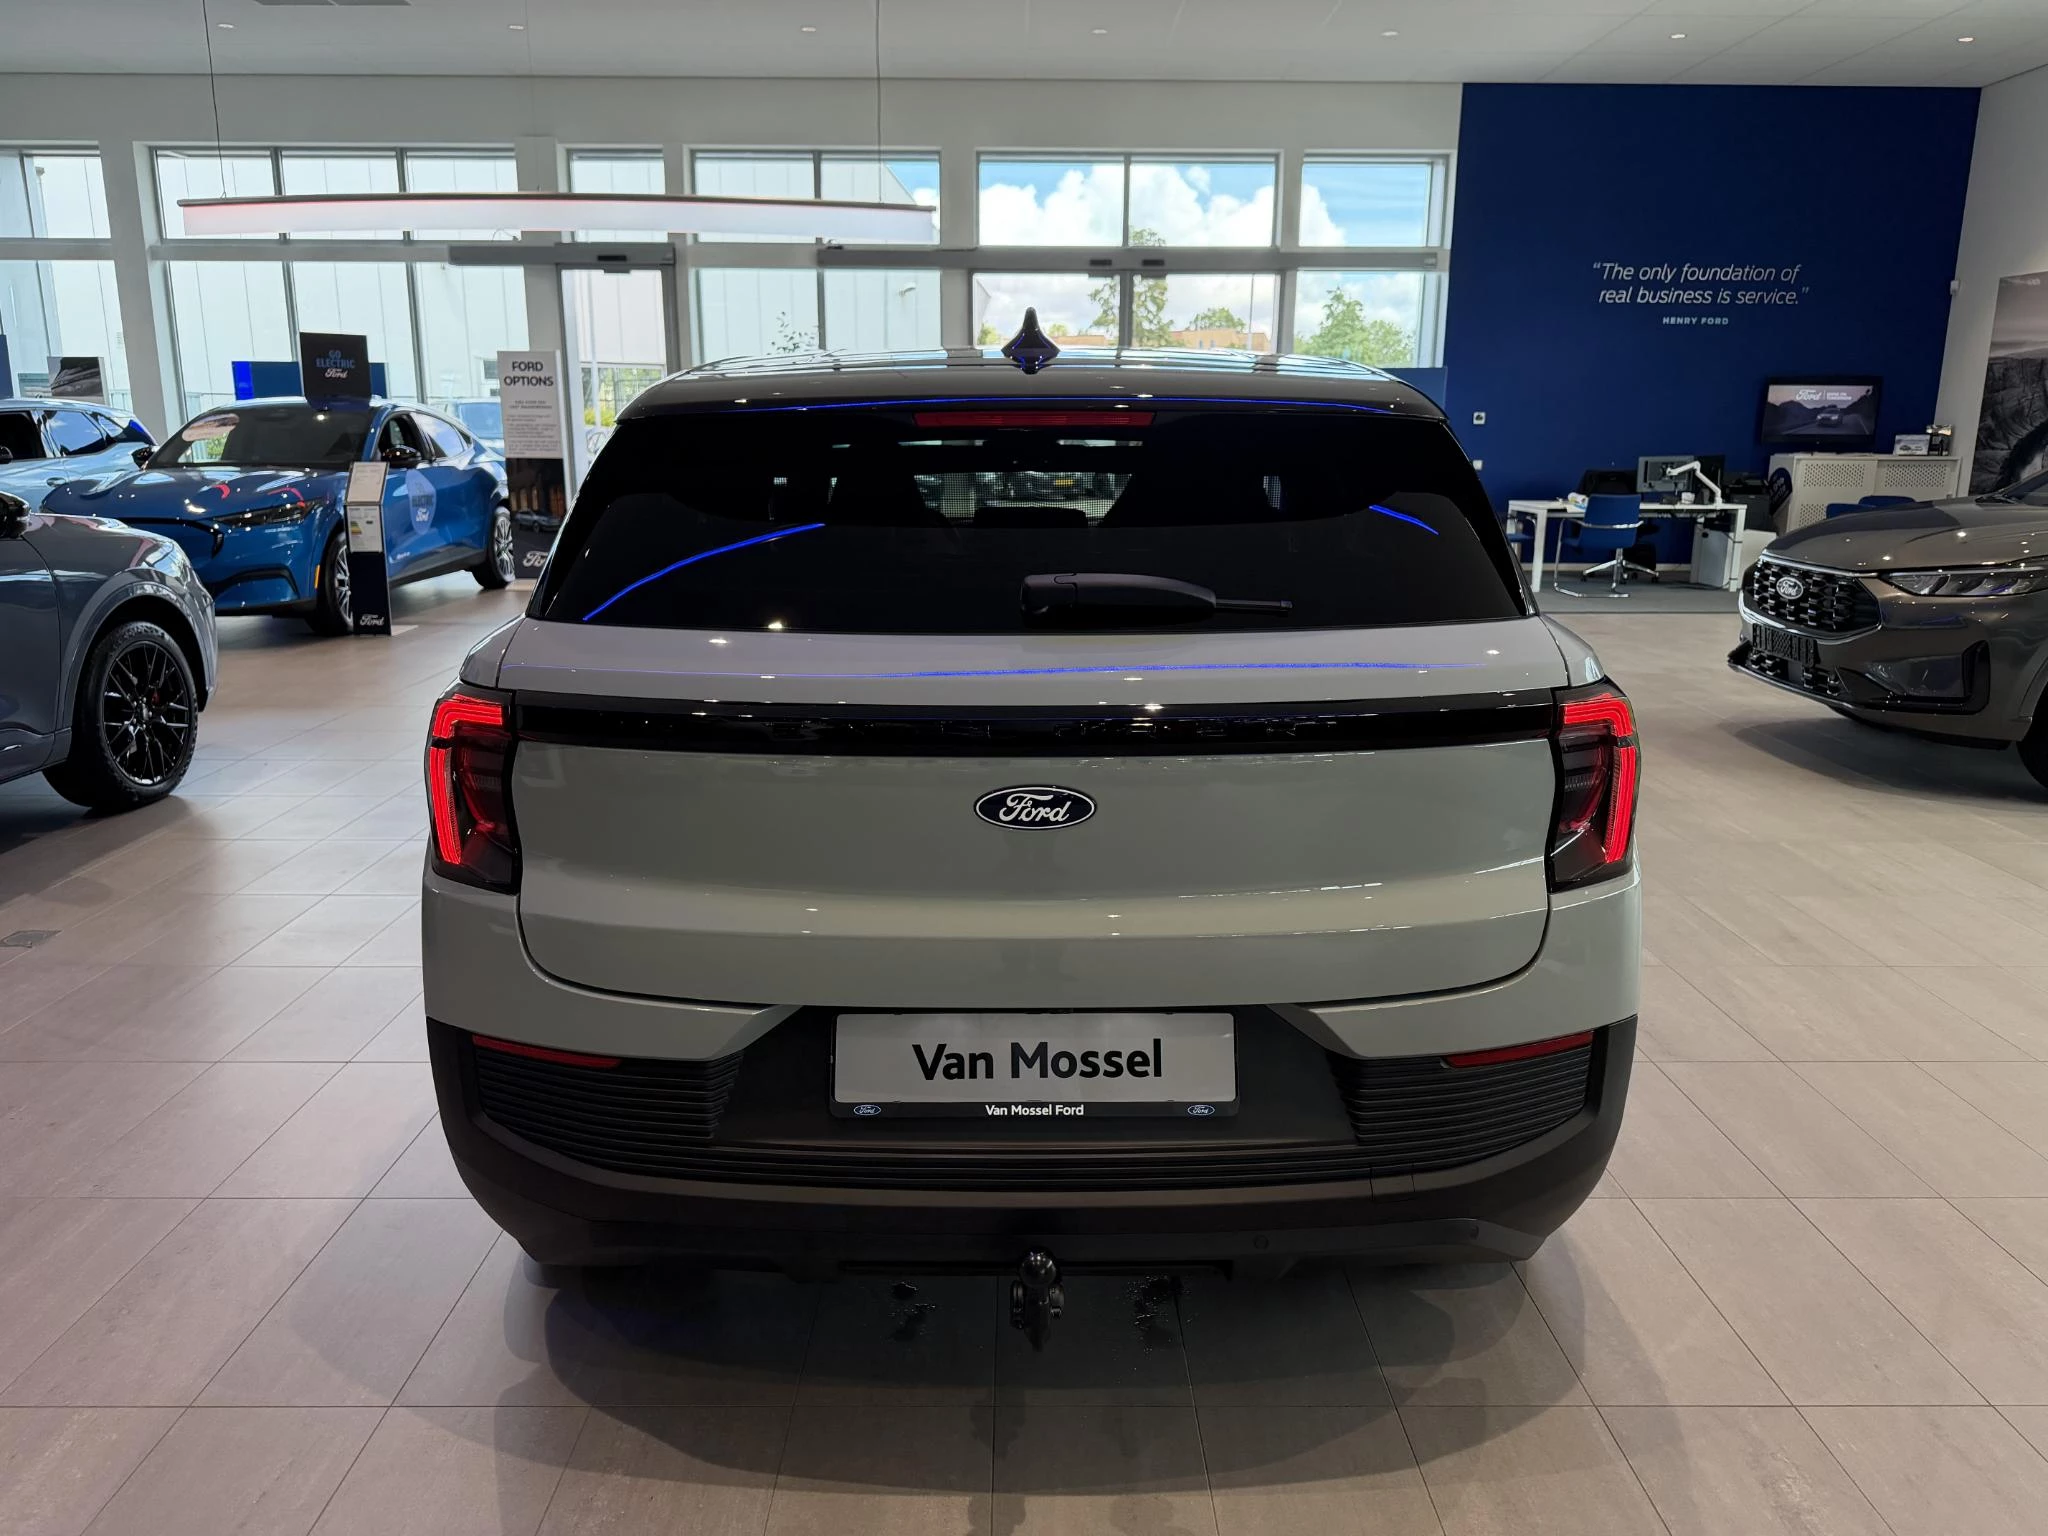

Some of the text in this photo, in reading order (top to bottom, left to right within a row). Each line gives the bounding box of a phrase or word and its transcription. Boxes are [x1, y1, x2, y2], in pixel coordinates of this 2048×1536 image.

[1639, 263, 1678, 284] only
[1681, 263, 1776, 284] foundation
[1780, 264, 1802, 284] of
[1599, 287, 1633, 304] real
[1637, 287, 1714, 304] business
[1717, 288, 1731, 304] is
[1662, 316, 1730, 326] HENRY FORD
[315, 357, 356, 369] ELECTRIC
[511, 361, 544, 372] FORD
[324, 367, 349, 379] Ford
[503, 375, 554, 387] OPTIONS
[1796, 388, 1822, 400] Ford
[360, 613, 384, 626] Ford
[998, 792, 1072, 822] Ford
[912, 1038, 1162, 1081] Van Mossel
[984, 1104, 1085, 1116] Van Mossel Ford
